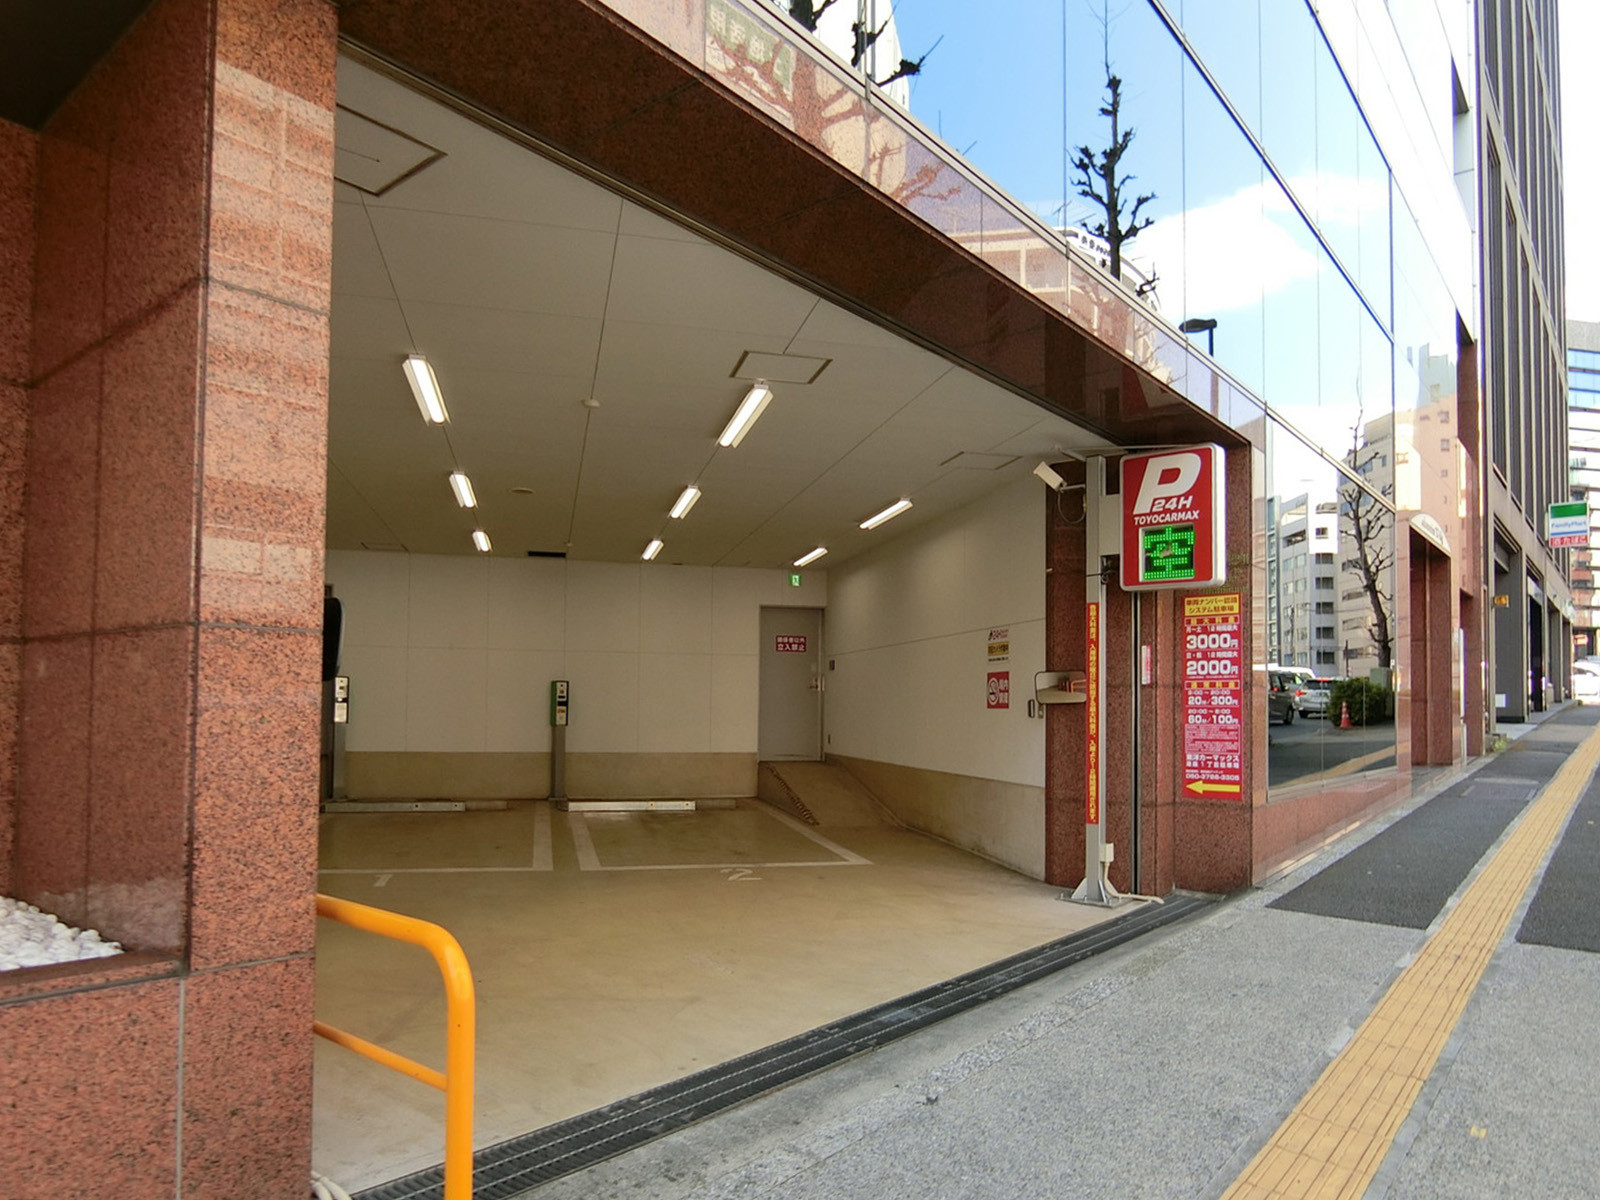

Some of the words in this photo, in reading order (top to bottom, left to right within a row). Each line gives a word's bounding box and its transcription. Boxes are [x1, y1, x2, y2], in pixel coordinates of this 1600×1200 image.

[1133, 452, 1201, 515] P
[1152, 496, 1192, 512] 24H
[1134, 510, 1199, 525] TOYOCARMAX
[777, 643, 805, 651] 立入禁止
[1186, 633, 1238, 649] 3000円
[1186, 660, 1238, 675] 2000円
